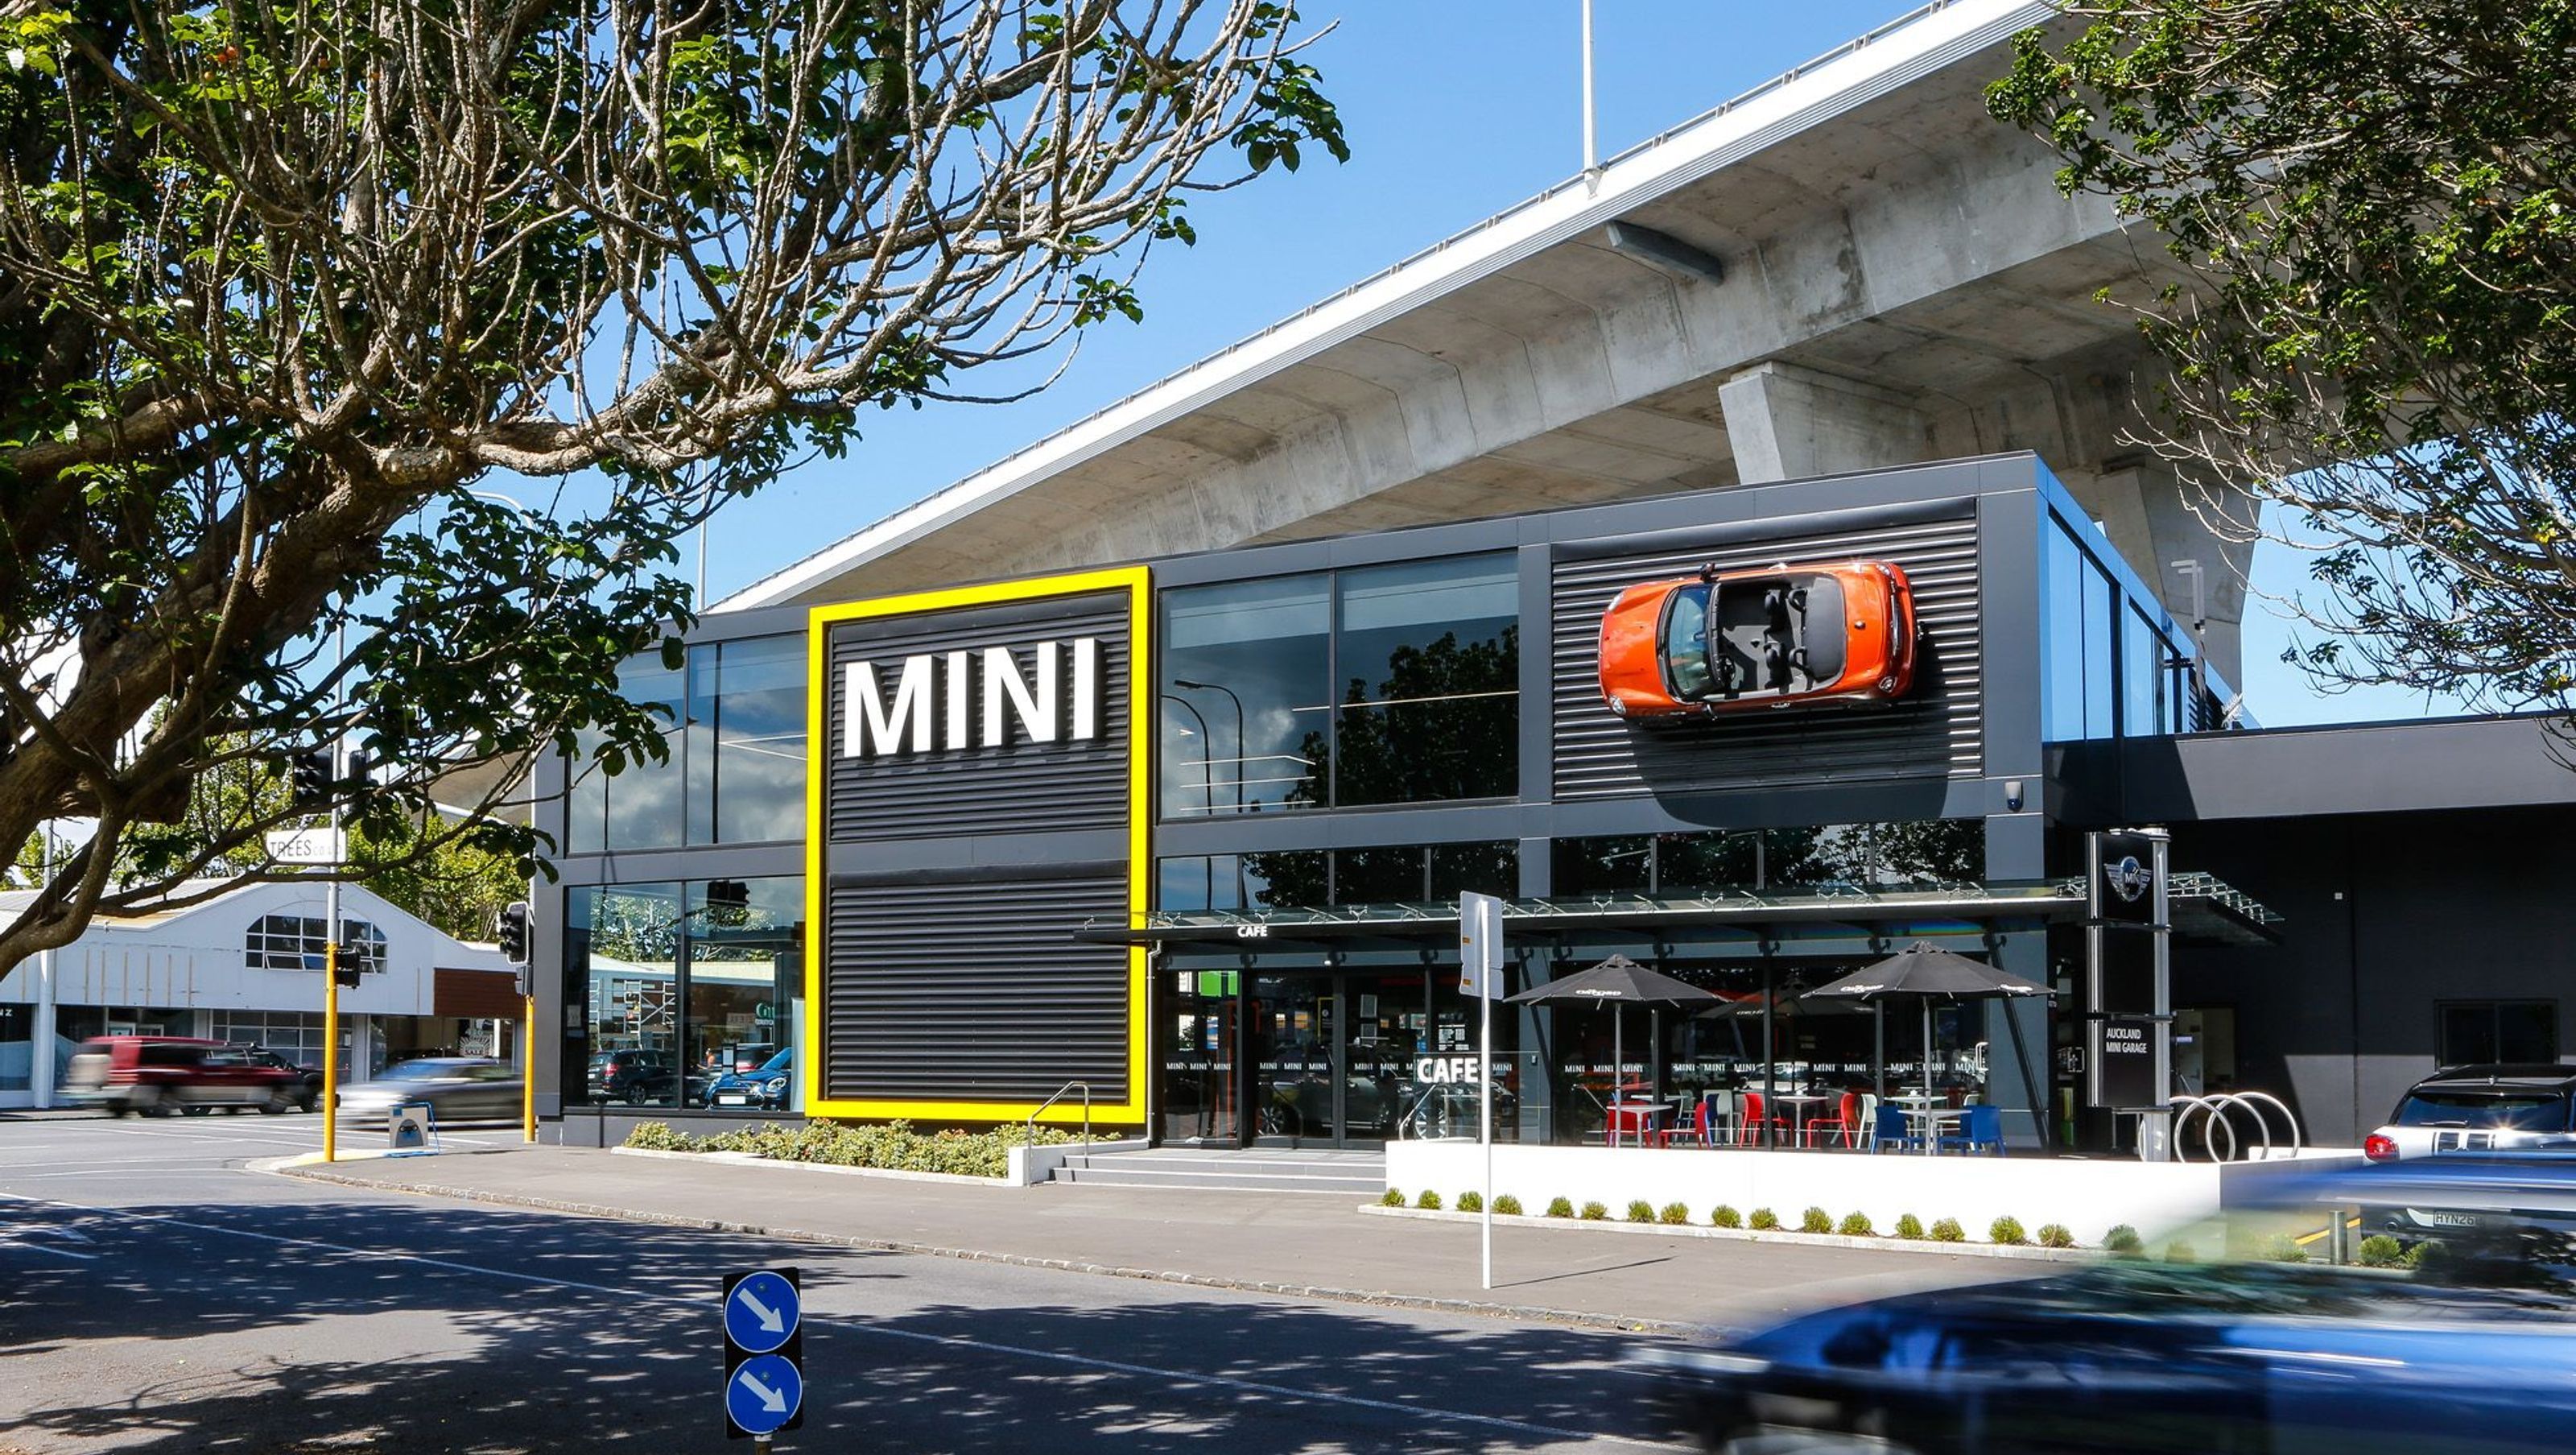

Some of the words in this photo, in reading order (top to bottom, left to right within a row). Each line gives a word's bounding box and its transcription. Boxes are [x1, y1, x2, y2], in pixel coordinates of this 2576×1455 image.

[844, 637, 1096, 758] MINI
[1237, 926, 1268, 938] CAFE
[2106, 1027, 2141, 1040] AUCKLAND
[2106, 1041, 2121, 1052] MINI
[2122, 1042, 2148, 1054] GARAGE
[1190, 1062, 1208, 1070] MINI
[1213, 1062, 1232, 1071] MINI
[1259, 1062, 1278, 1070] MINI
[1284, 1062, 1302, 1070] MINI
[1308, 1062, 1327, 1070] MINI
[1417, 1057, 1479, 1084] CAFE
[1492, 1063, 1513, 1072] MINI
[1564, 1064, 1585, 1073] MINI
[1593, 1064, 1614, 1073] MINI
[1703, 1064, 1725, 1072] MINI
[1813, 1063, 1835, 1073] MINI
[1843, 1063, 1867, 1073] MINI
[2435, 1213, 2484, 1225] HYN26
